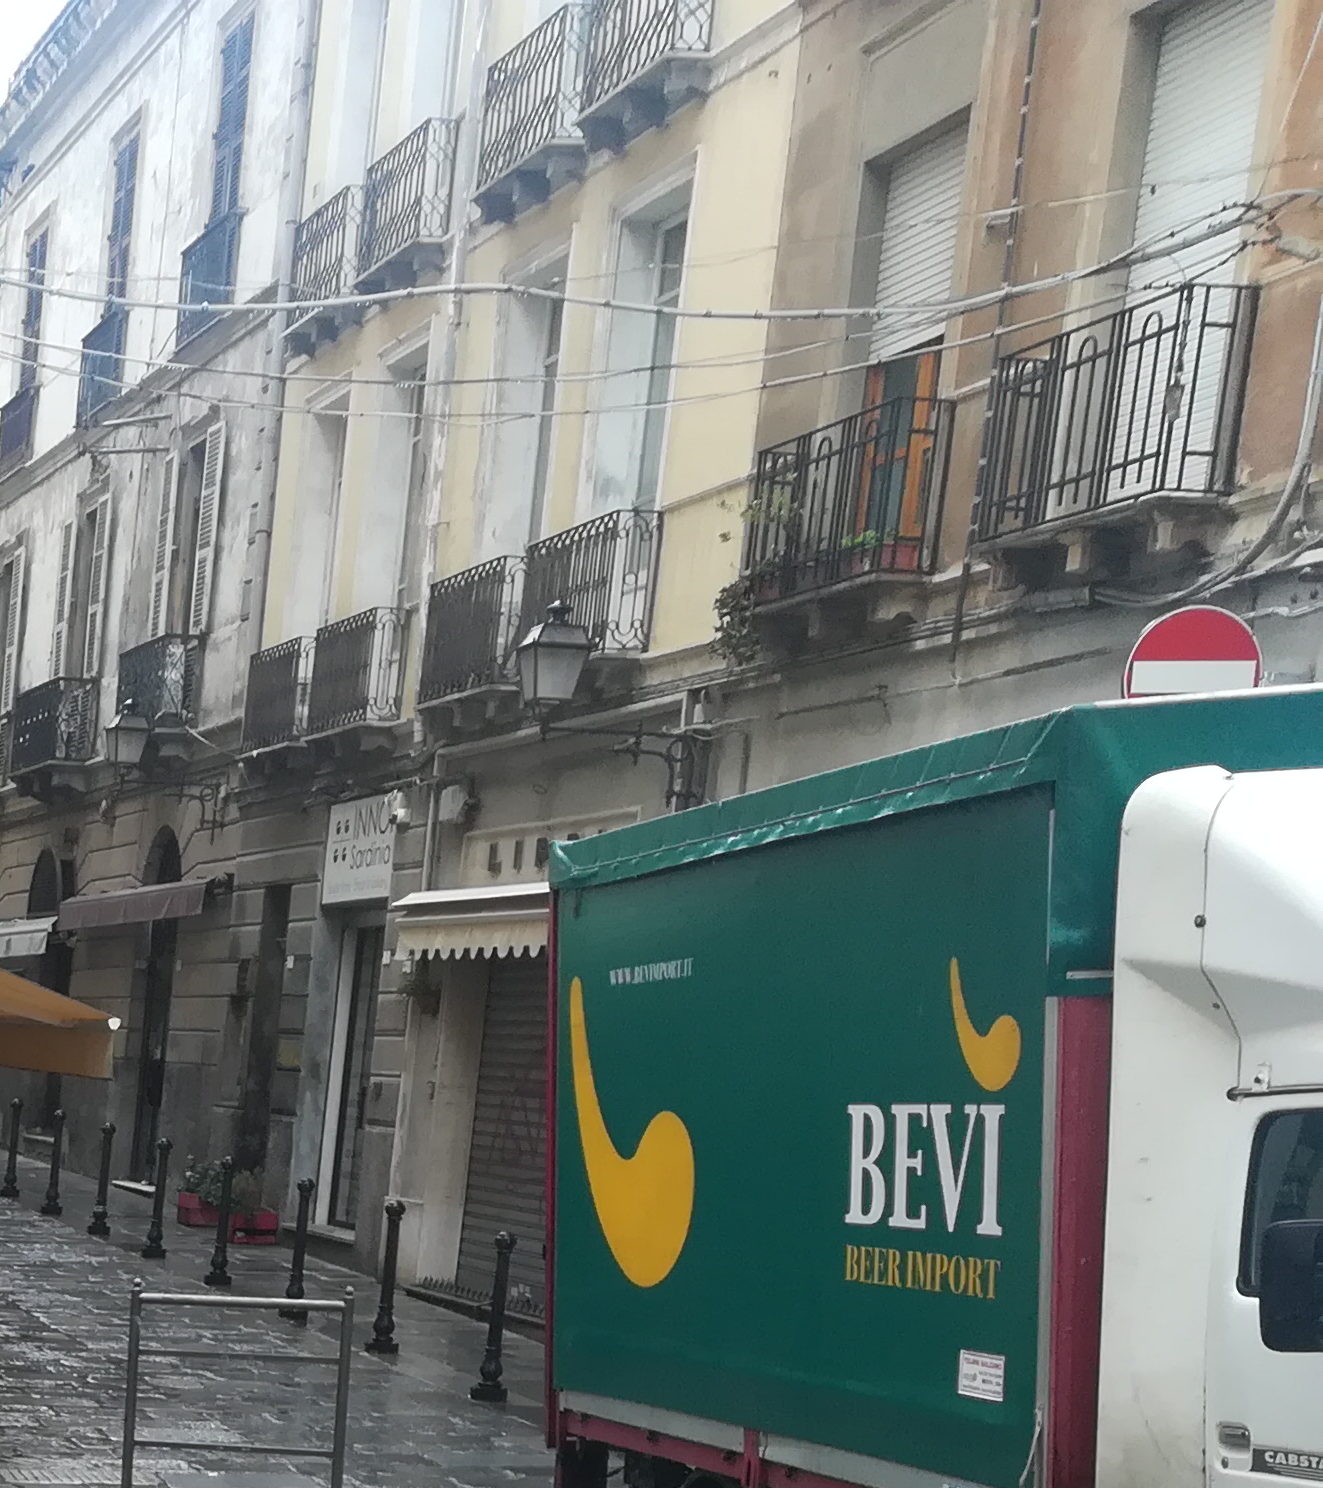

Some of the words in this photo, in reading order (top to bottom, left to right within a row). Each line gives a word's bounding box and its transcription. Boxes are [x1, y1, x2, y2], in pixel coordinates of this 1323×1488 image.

[844, 1103, 1005, 1236] BEVI
[845, 1244, 903, 1287] BEER
[905, 1250, 1002, 1299] IMPORT
